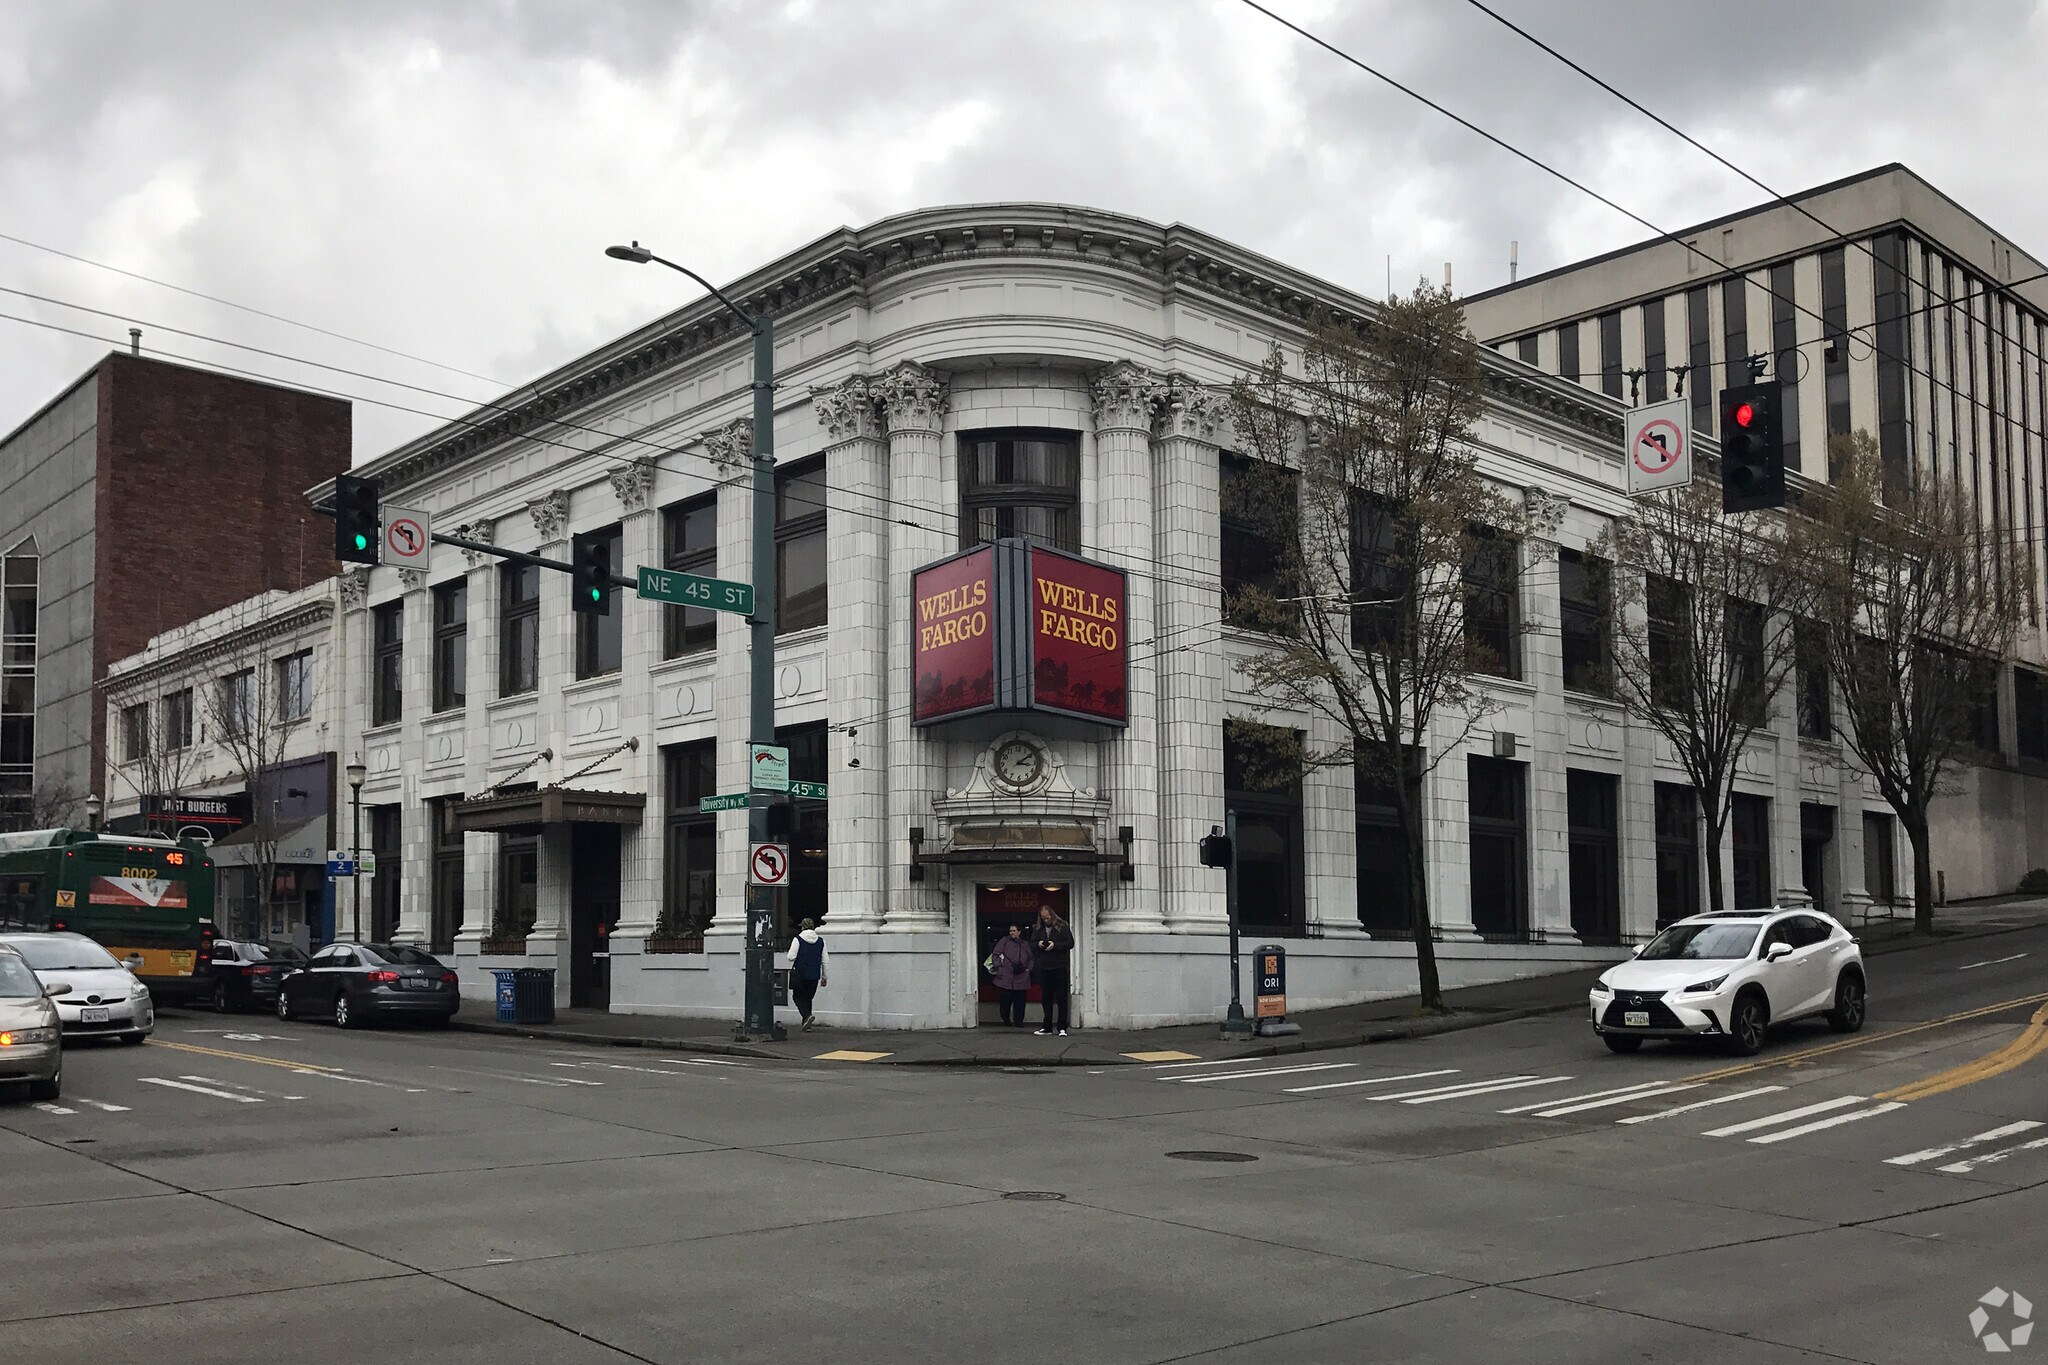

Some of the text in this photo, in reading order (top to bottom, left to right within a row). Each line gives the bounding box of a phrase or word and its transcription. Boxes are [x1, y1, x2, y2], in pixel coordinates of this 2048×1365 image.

[647, 574, 746, 605] NE 45 ST
[919, 579, 987, 622] WELLS
[1037, 578, 1117, 622] WELLS
[920, 610, 987, 652] FARGO
[1040, 609, 1117, 651] FARGO
[818, 786, 826, 796] St
[187, 801, 228, 814] BURGERS
[701, 796, 730, 811] University
[738, 797, 745, 806] NE
[577, 805, 623, 817] BANK
[166, 852, 184, 865] 45
[337, 861, 344, 870] 2
[121, 866, 157, 880] 8002
[1264, 977, 1279, 988] ORI
